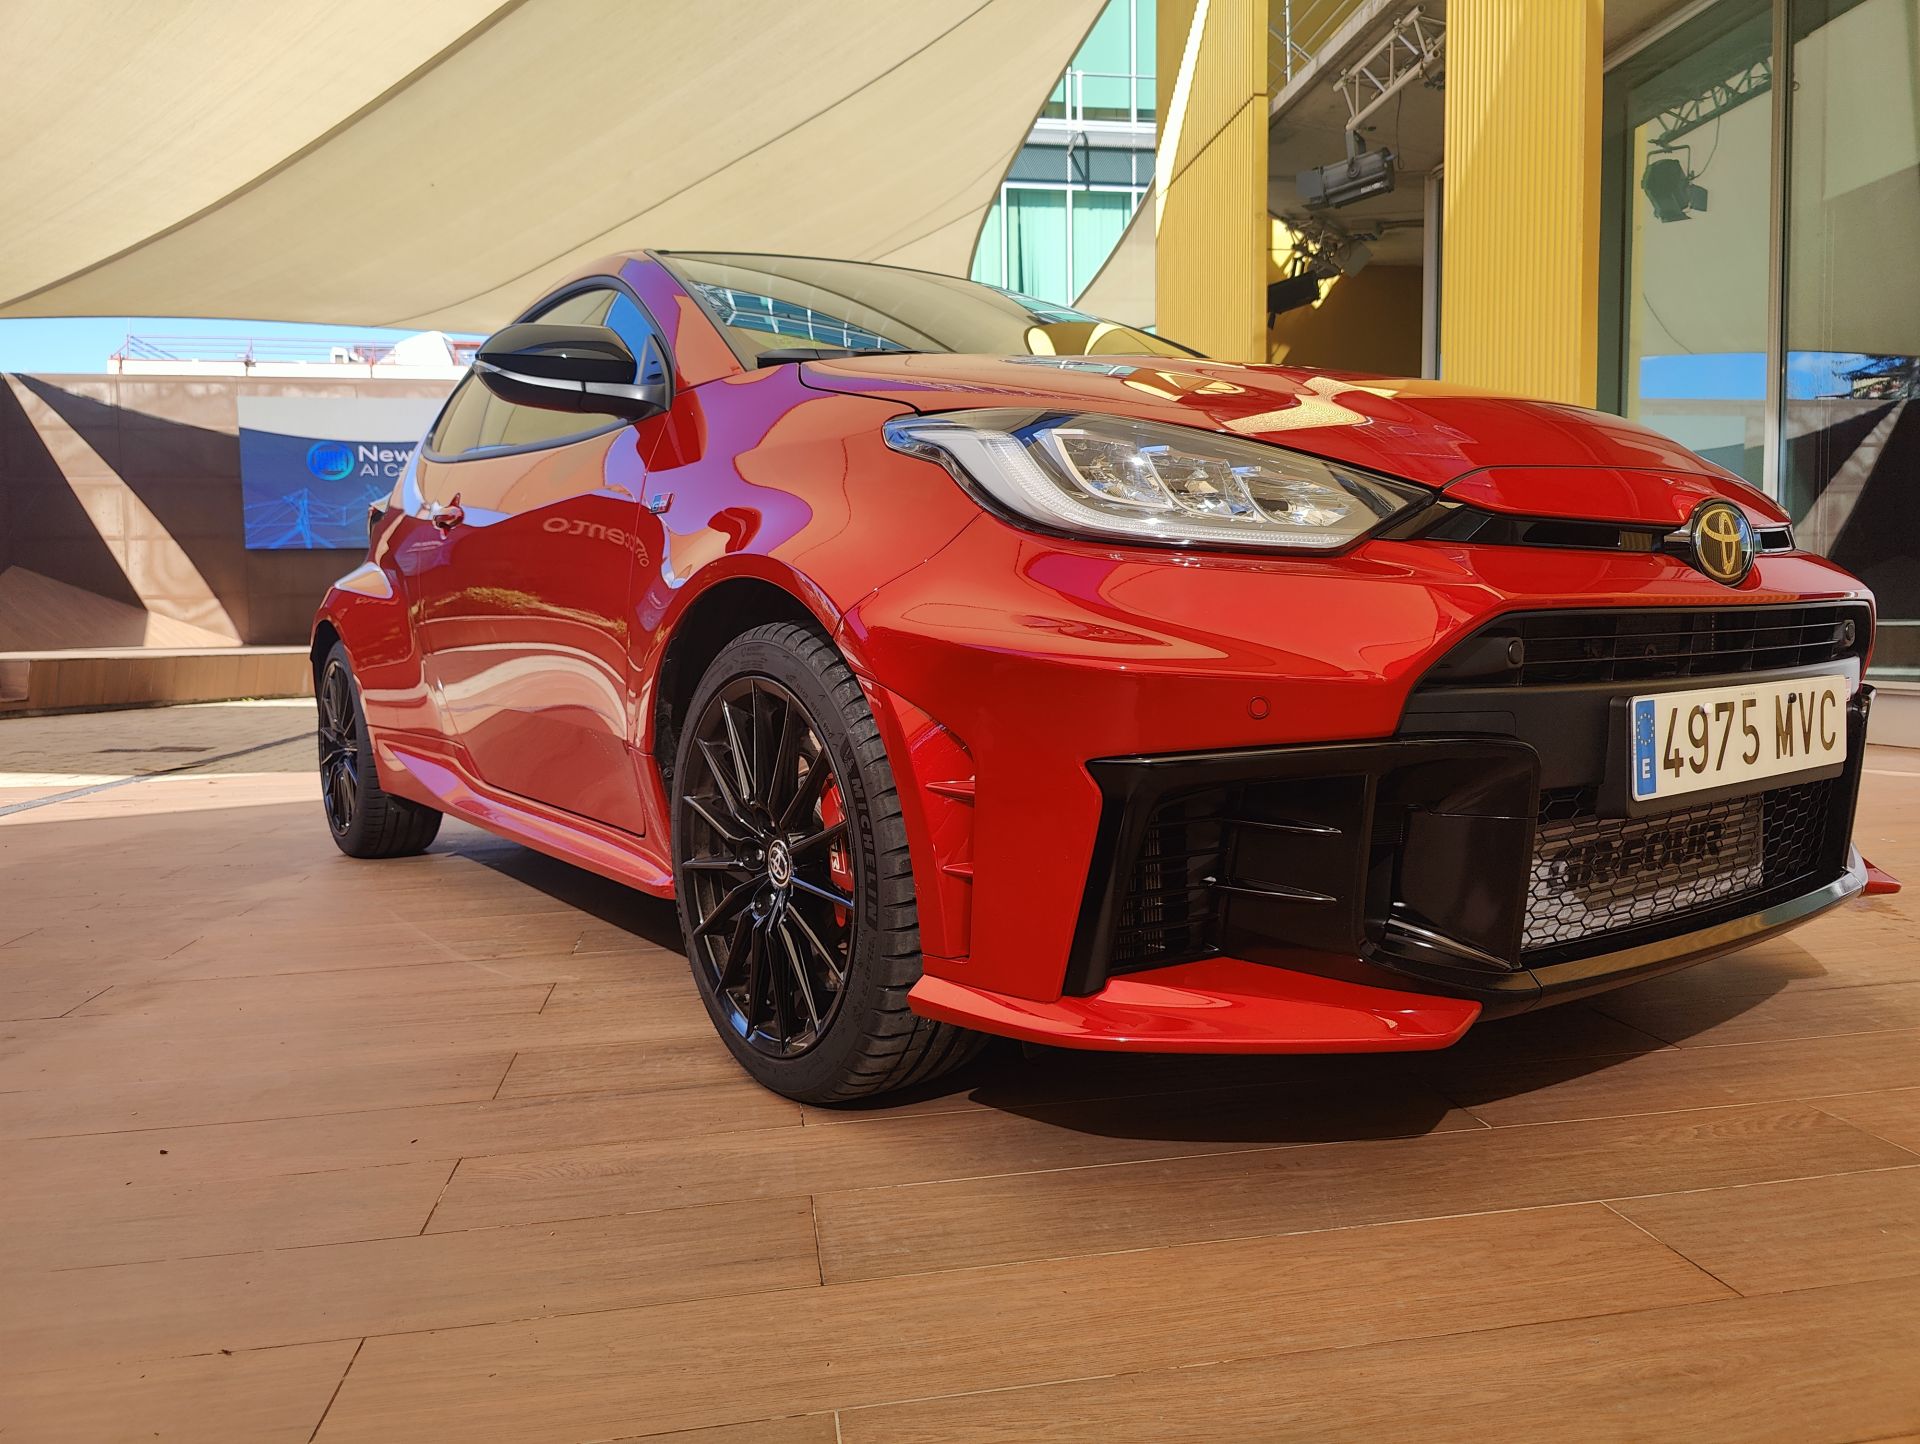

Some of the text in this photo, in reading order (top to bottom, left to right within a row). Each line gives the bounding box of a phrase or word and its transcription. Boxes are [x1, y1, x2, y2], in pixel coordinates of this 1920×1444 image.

[1642, 758, 1651, 779] E
[1663, 689, 1836, 779] 4975 MVC
[851, 776, 878, 928] MICHELIN
